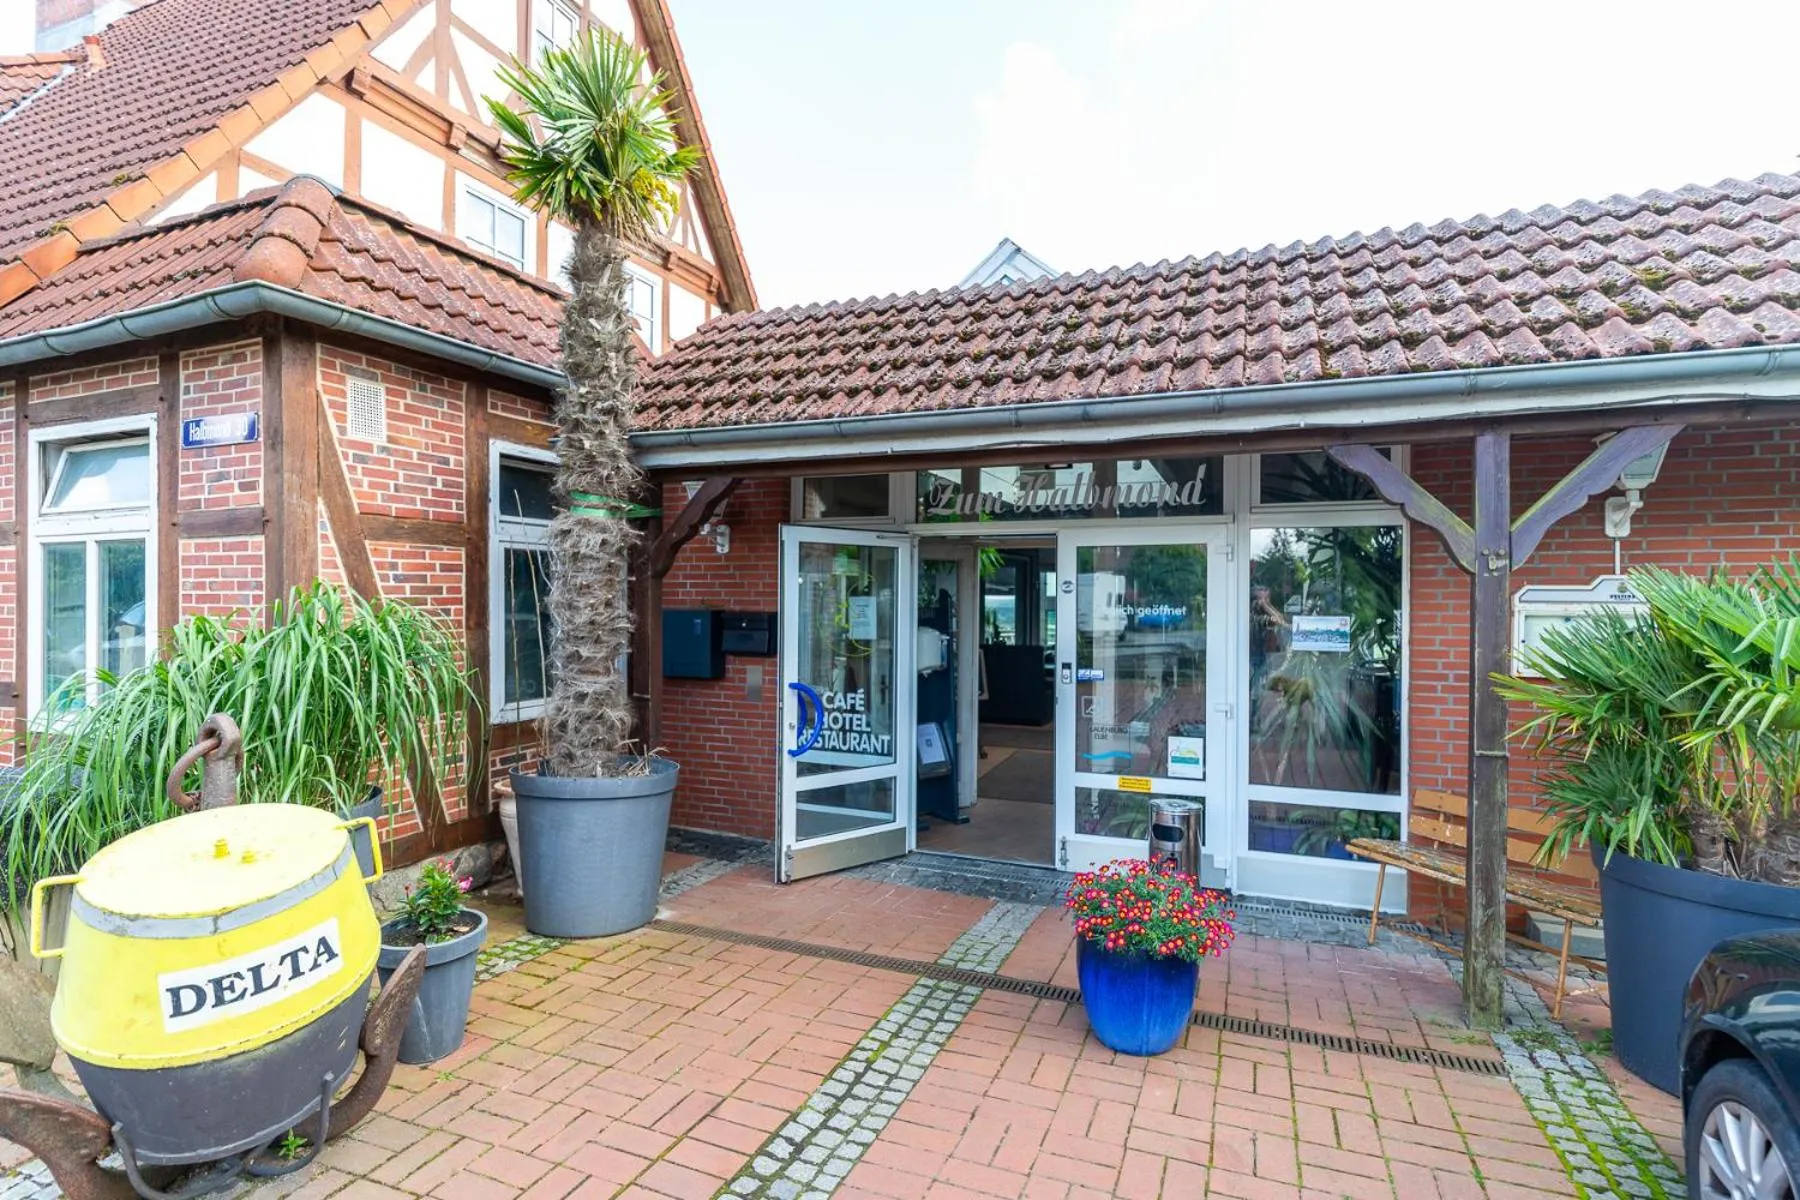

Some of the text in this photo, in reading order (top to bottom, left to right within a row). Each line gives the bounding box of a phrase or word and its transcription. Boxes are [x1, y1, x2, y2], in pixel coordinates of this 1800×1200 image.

[927, 464, 1207, 517] Zum Halbmond
[1137, 604, 1187, 618] geöffnet
[822, 688, 865, 711] CAFÉ
[165, 935, 339, 1019] DELTA
